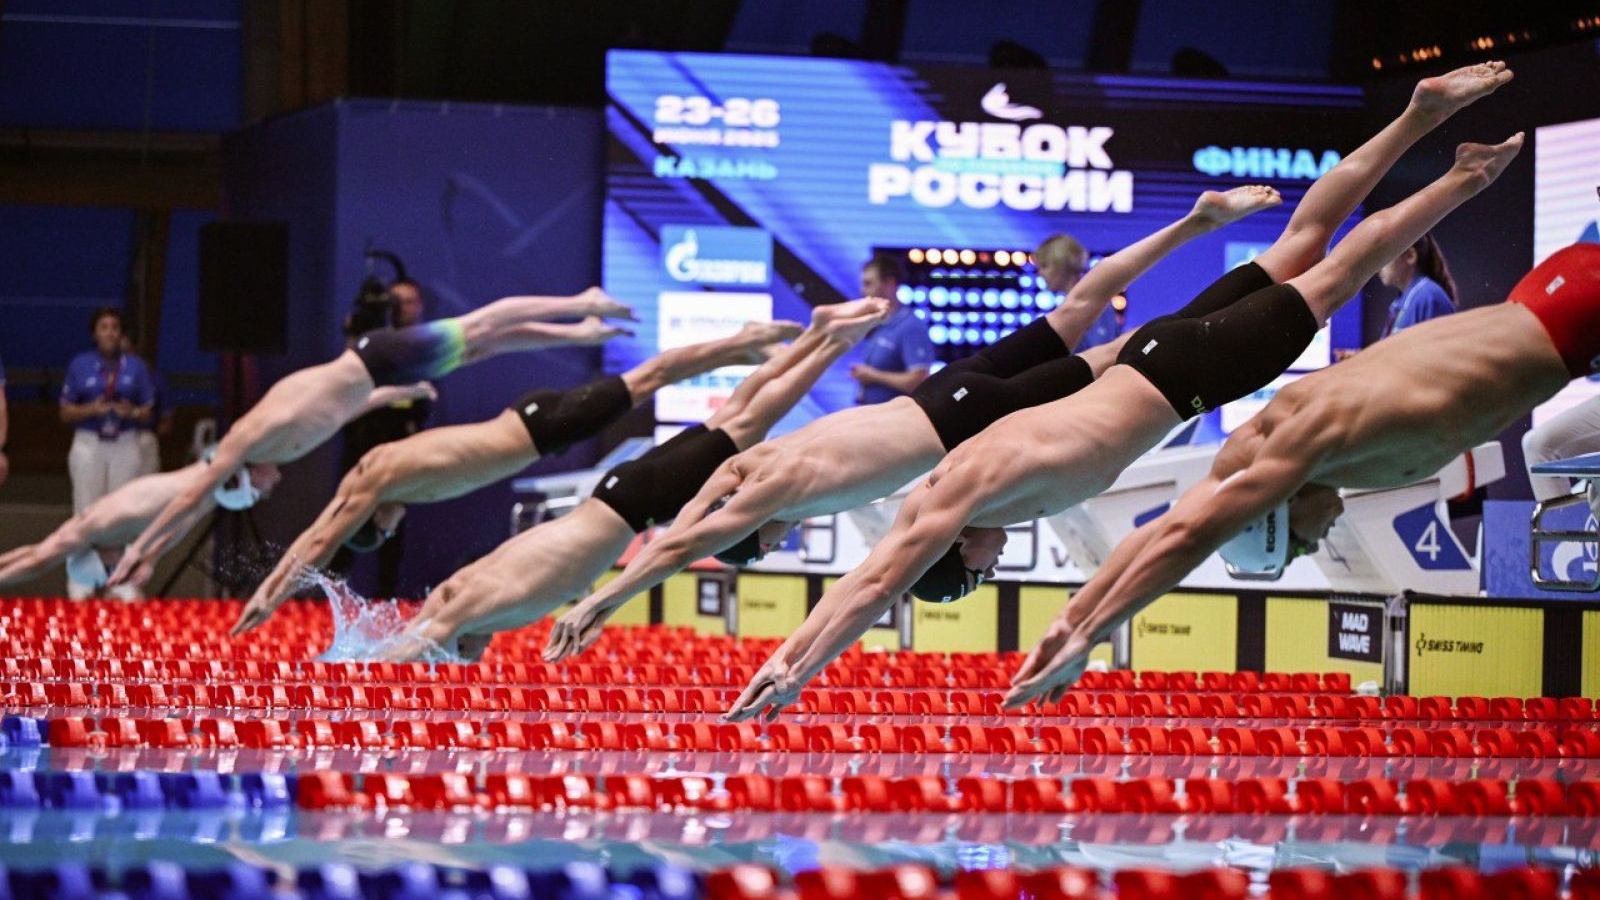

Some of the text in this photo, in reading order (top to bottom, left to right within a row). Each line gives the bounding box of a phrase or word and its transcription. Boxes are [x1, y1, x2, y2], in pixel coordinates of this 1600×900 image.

[891, 121, 1113, 169] КУБОК
[869, 163, 1133, 212] РОССИИ
[1415, 520, 1441, 561] 4
[1342, 612, 1369, 632] MAD
[1339, 633, 1371, 653] WAVE
[1428, 640, 1484, 654] SWISS TIMING
